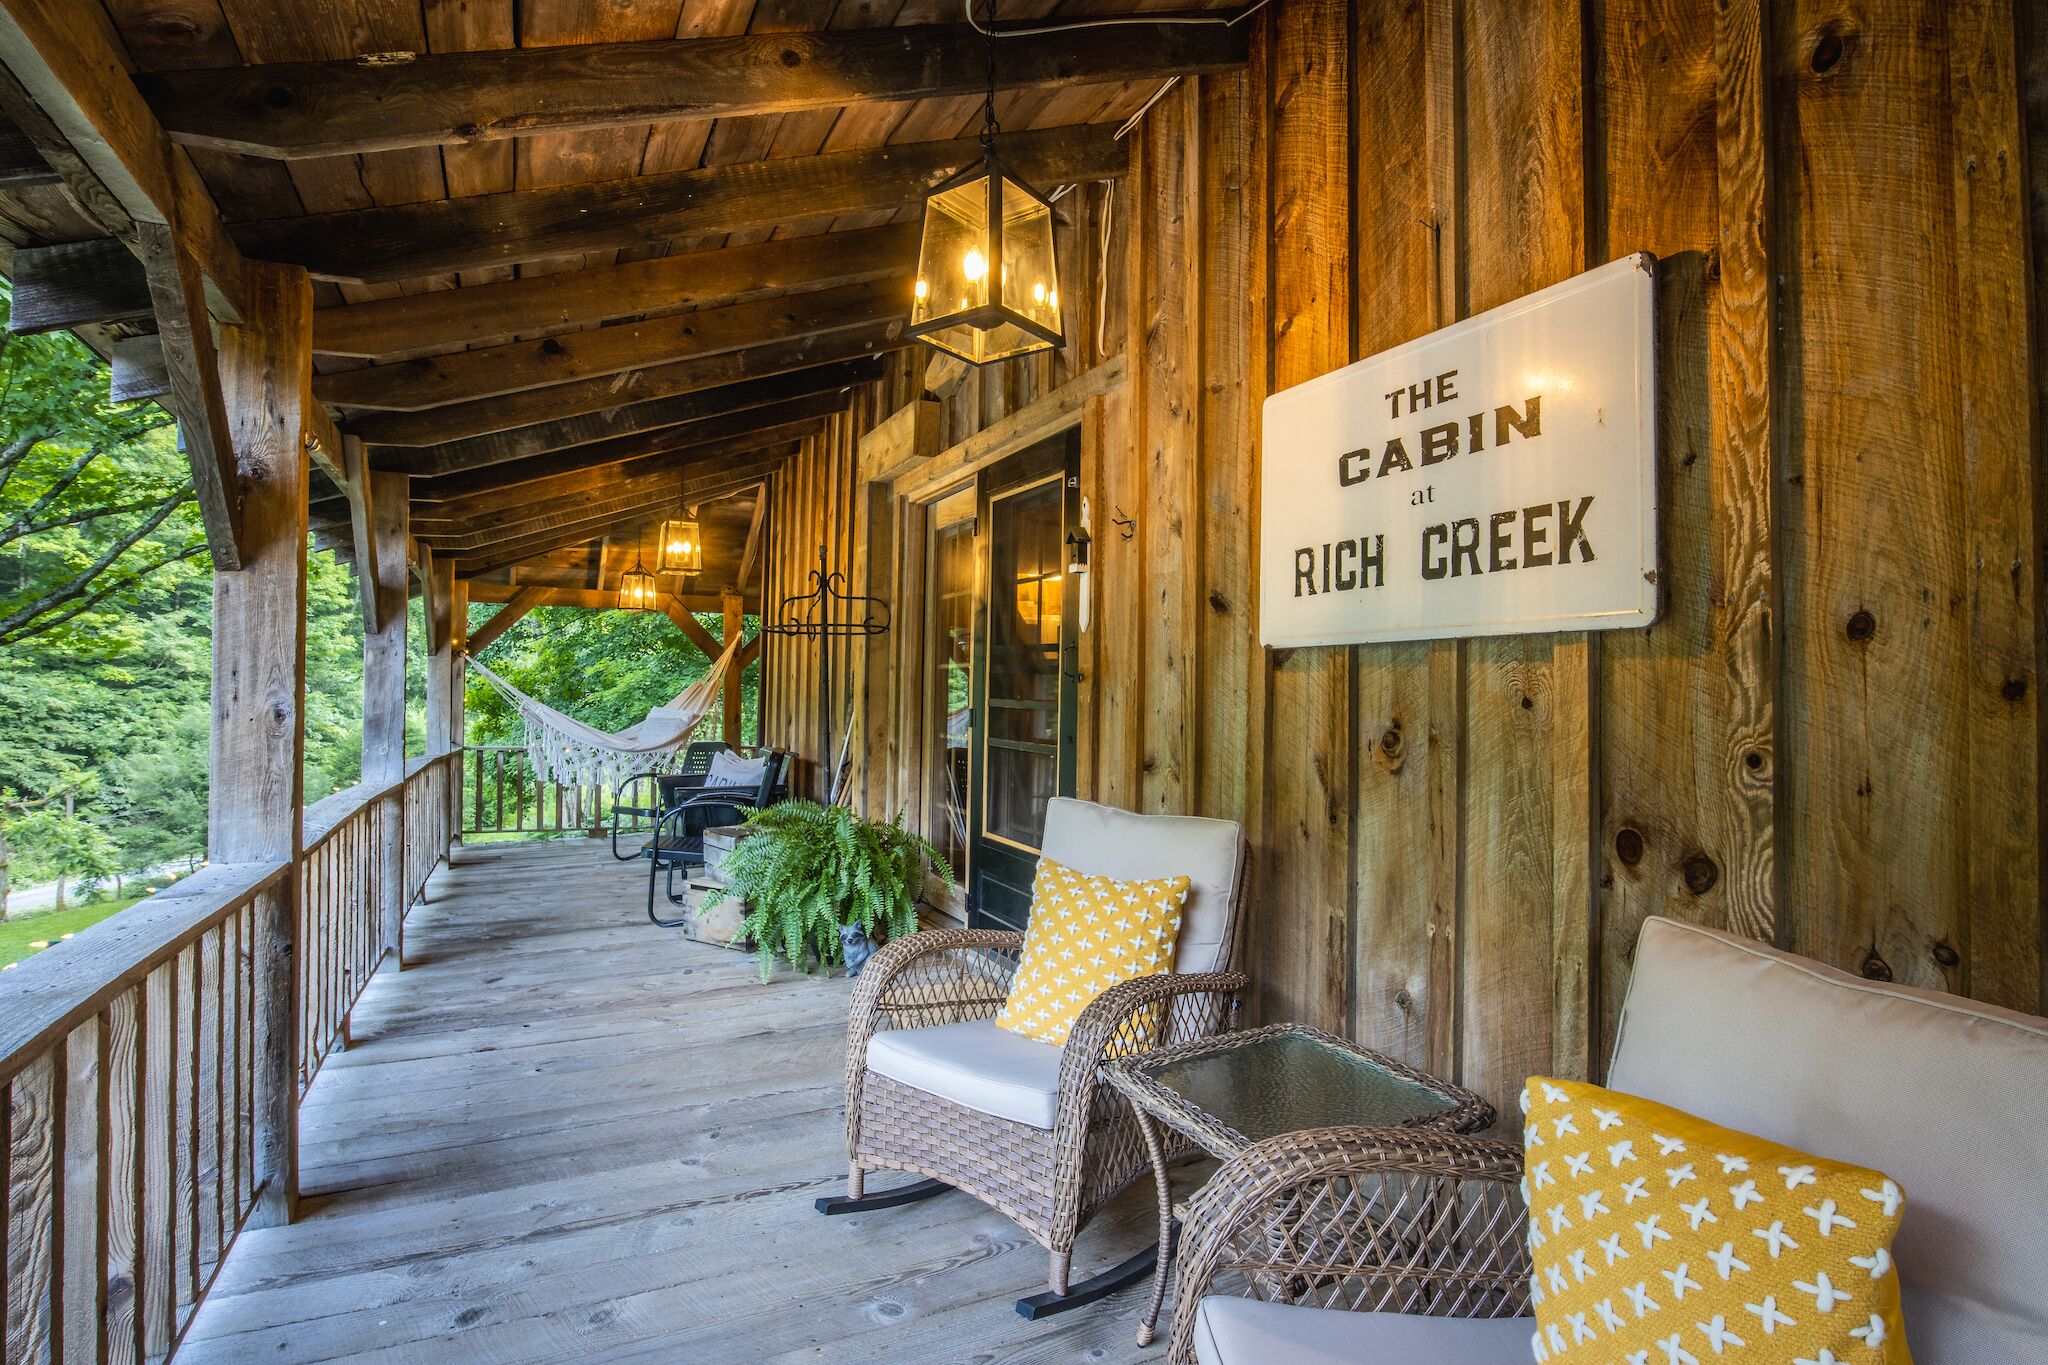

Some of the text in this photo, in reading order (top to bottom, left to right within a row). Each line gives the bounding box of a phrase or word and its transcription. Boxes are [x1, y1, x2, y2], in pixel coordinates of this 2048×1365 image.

[1385, 369, 1459, 419] THE
[1338, 395, 1542, 488] CABIN
[1411, 484, 1436, 507] at
[1294, 495, 1597, 598] RICH CREEK
